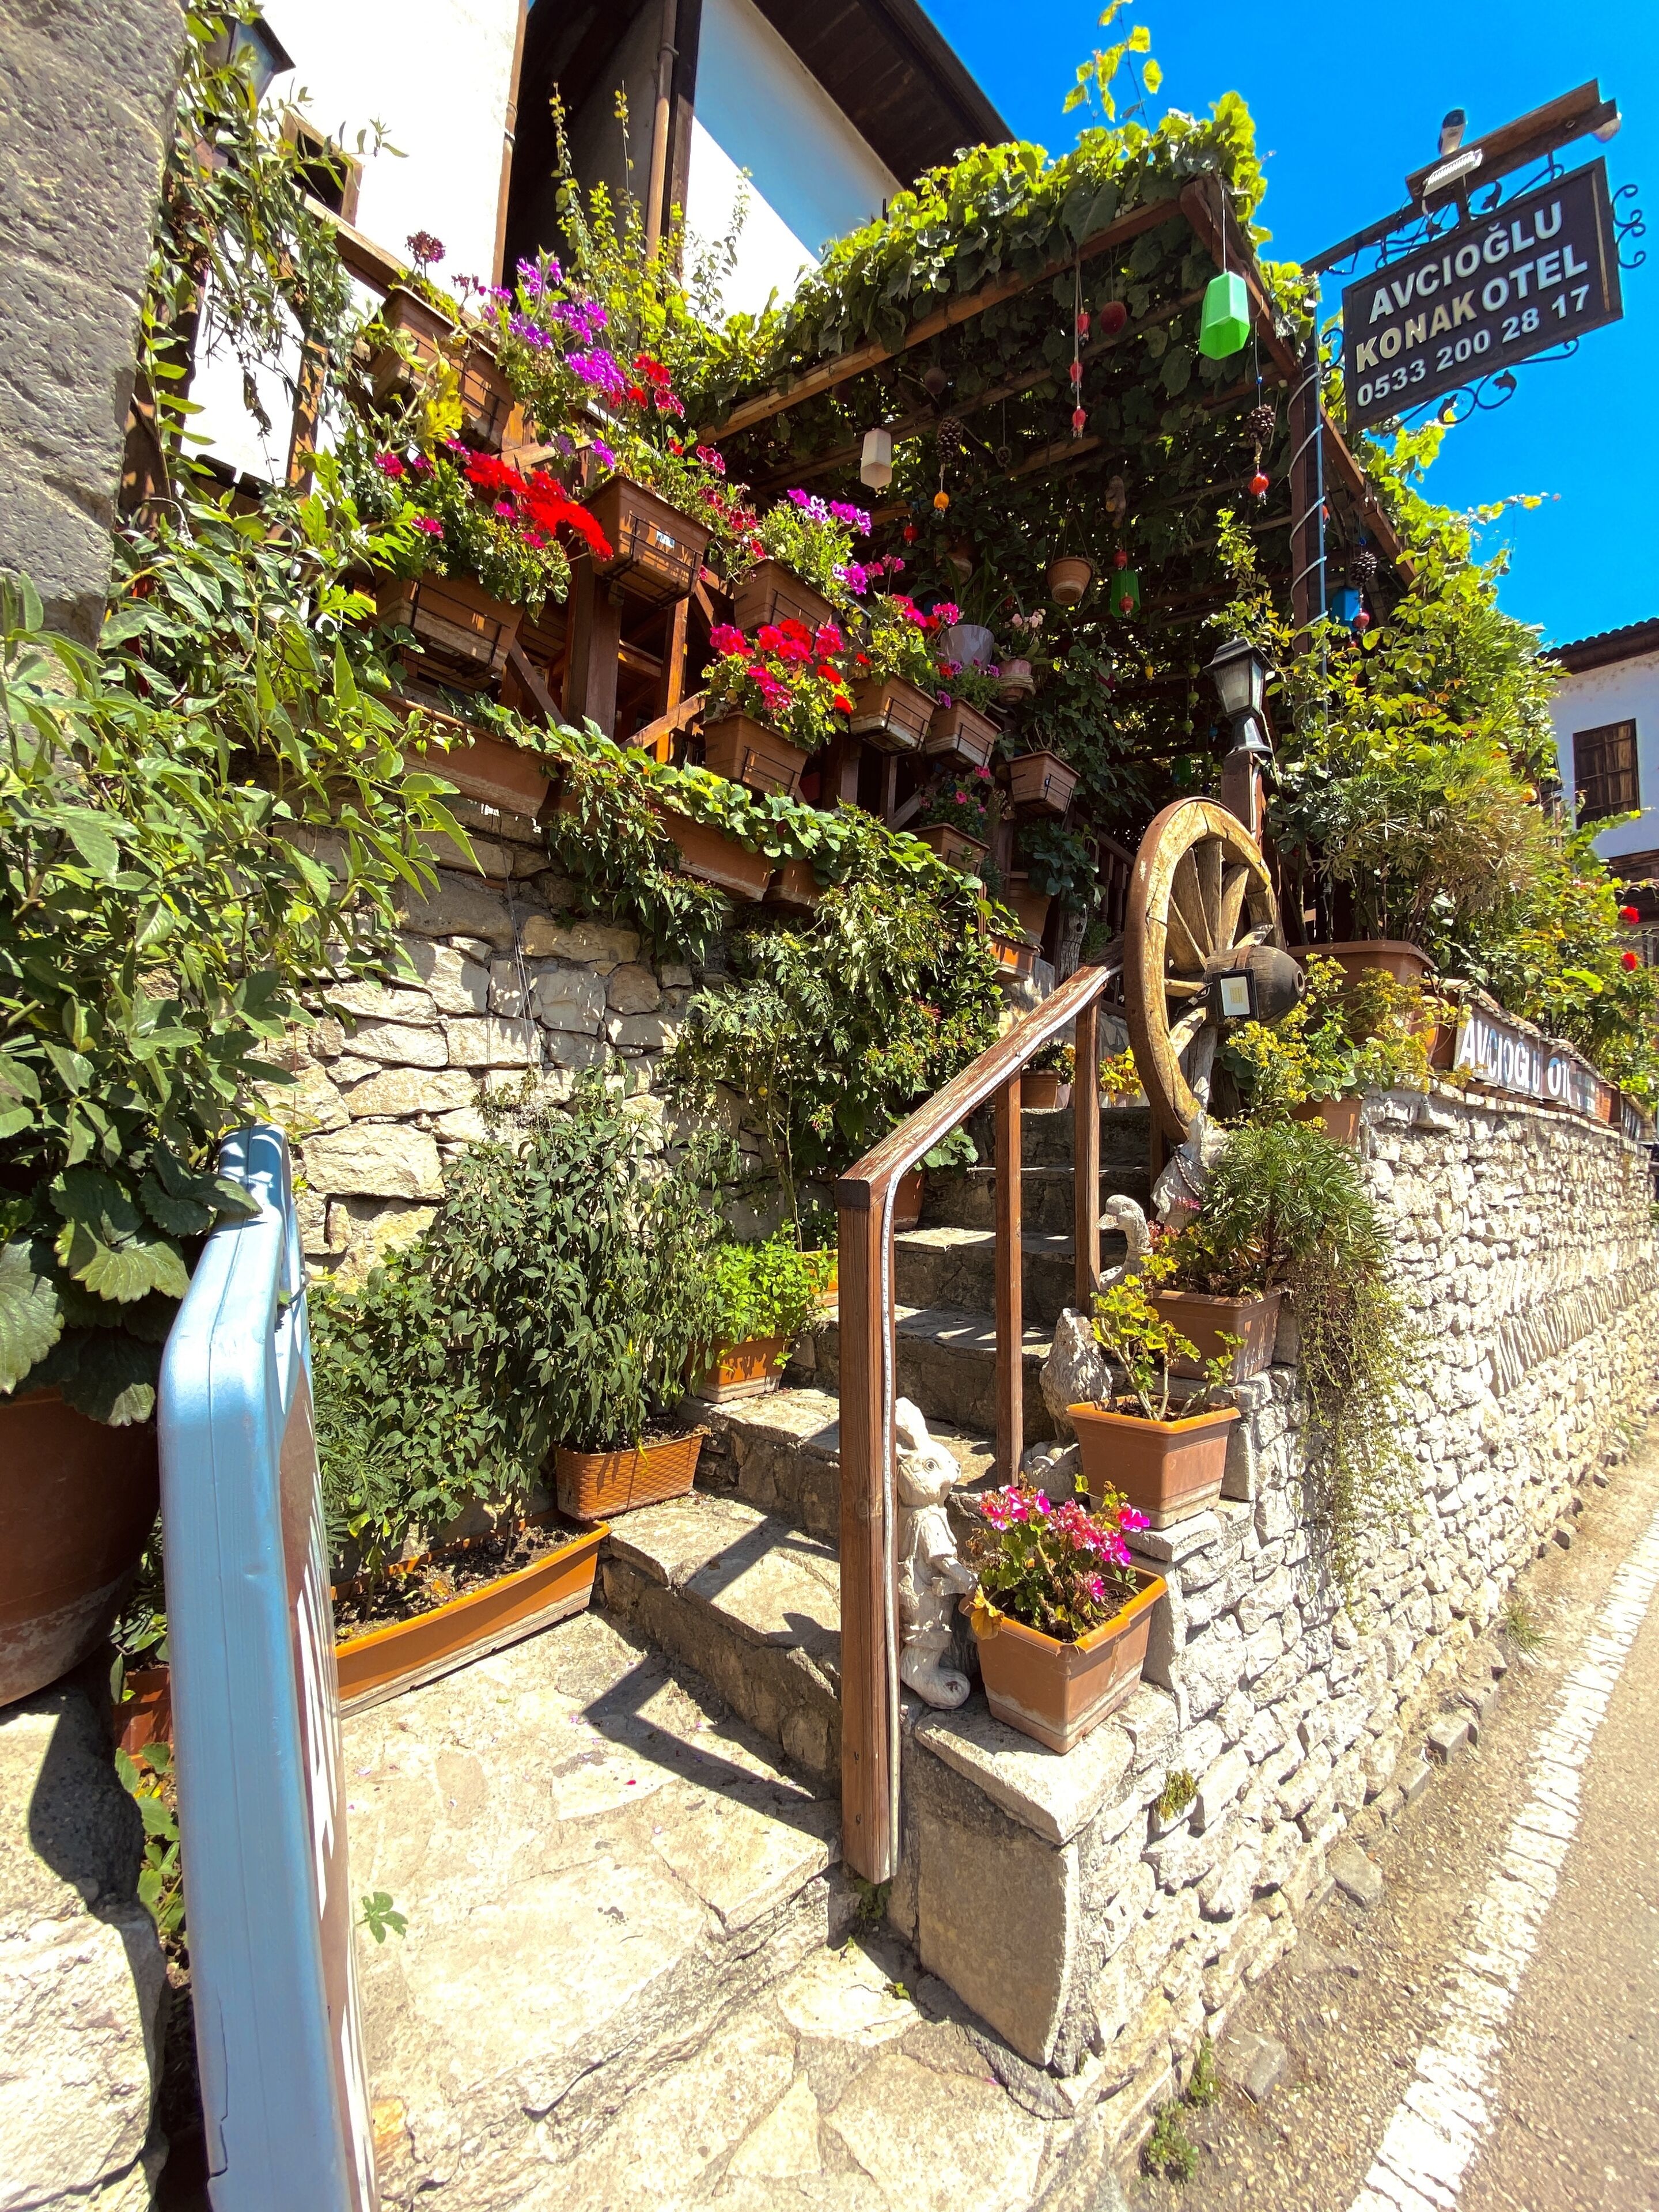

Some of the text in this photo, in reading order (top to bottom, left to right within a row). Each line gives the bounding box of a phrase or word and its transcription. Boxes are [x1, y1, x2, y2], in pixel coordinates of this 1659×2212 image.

[1355, 244, 1588, 373] KONAK OTEL
[1369, 200, 1562, 324] AVCIOĞLU
[1357, 284, 1590, 407] 0533 200 28 17
